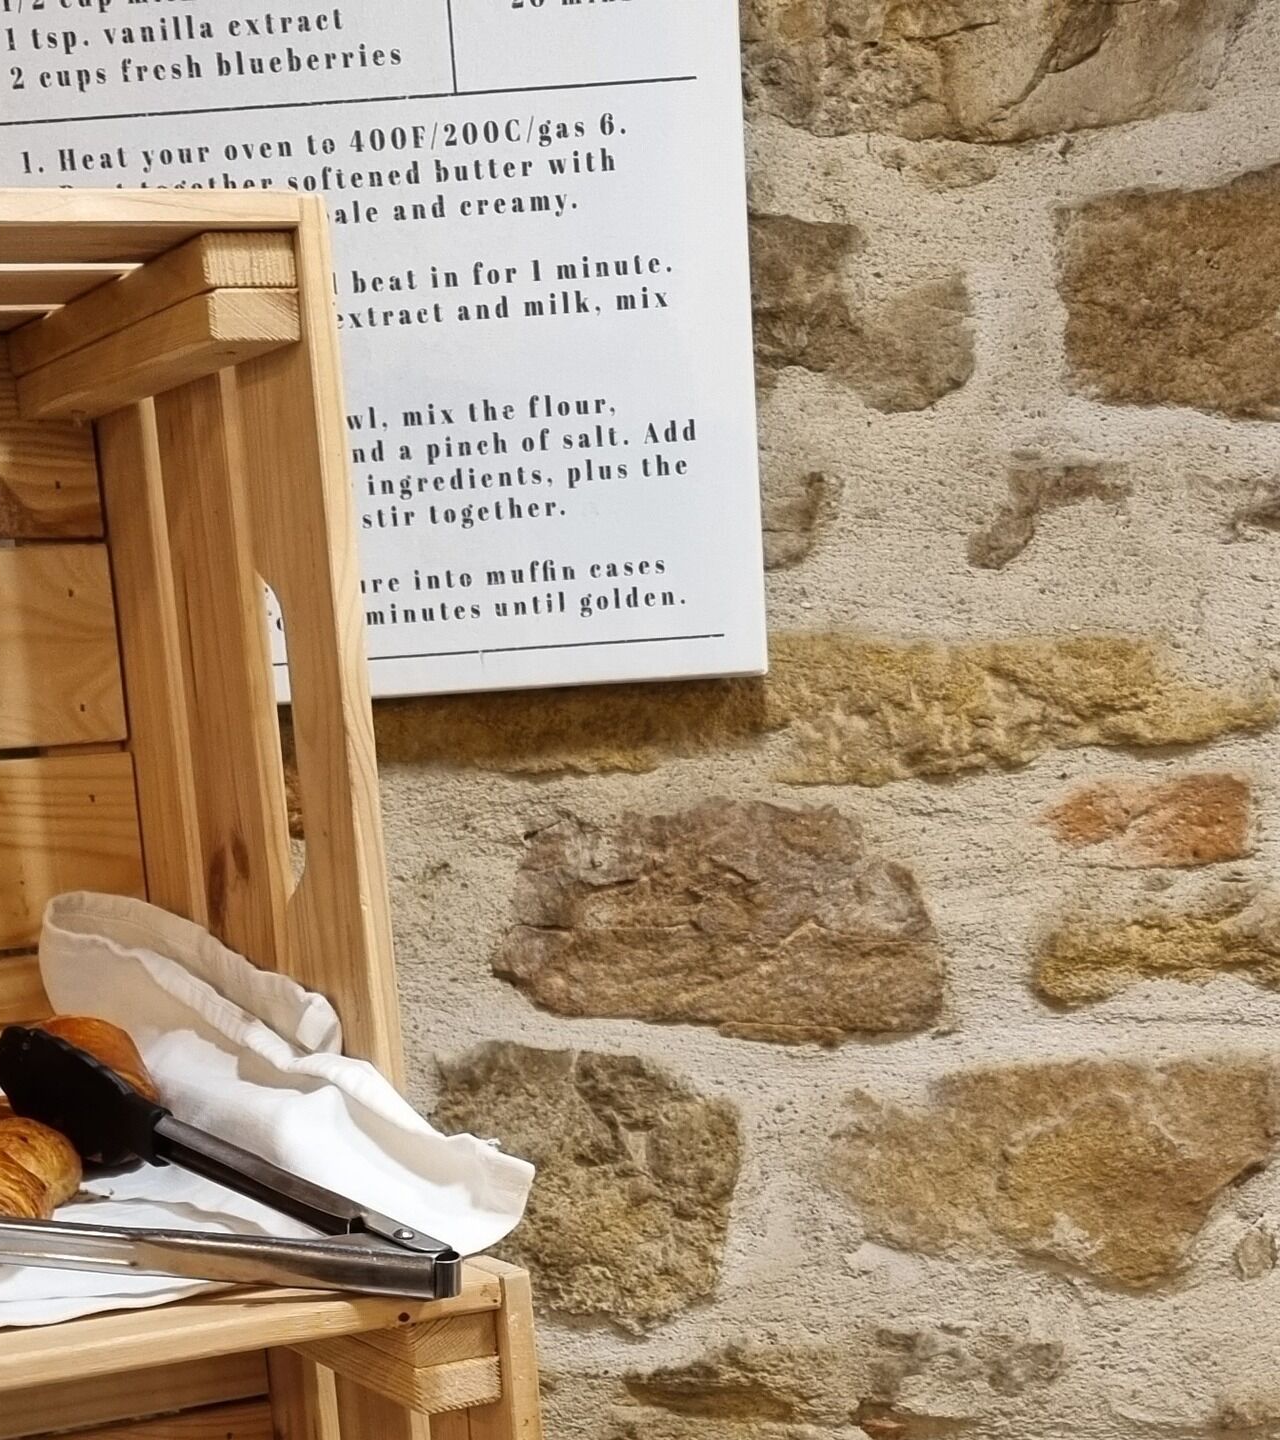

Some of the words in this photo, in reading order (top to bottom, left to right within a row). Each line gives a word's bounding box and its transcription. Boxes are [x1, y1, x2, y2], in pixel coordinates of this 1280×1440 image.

[5, 28, 17, 50] 1
[31, 28, 89, 54] tsp.
[103, 15, 214, 45] vanilla
[228, 8, 344, 37] extract
[10, 67, 25, 90] 2
[39, 66, 107, 92] cups
[121, 55, 202, 83] fresh
[216, 43, 402, 76] blueberries
[21, 151, 44, 174] 1.
[58, 147, 128, 172] Heat
[141, 146, 210, 173] your
[224, 139, 293, 161] oven
[307, 135, 336, 156] to
[349, 115, 585, 153] 400F/200C/gas
[599, 112, 627, 136] 6.
[287, 160, 420, 191] softened
[434, 158, 533, 183] butter
[548, 148, 616, 175] with
[328, 200, 379, 225] ale
[393, 194, 446, 221] and
[459, 193, 578, 217] creamy.
[351, 269, 418, 294] beat
[430, 266, 459, 289] in
[472, 261, 518, 286] for
[531, 259, 542, 282] 1
[556, 254, 673, 281] minute.
[457, 295, 510, 322] and
[523, 290, 602, 318] milk,
[616, 286, 669, 311] mix
[402, 403, 455, 427] mix
[469, 399, 516, 422] the
[529, 395, 616, 418] flour,
[399, 445, 412, 461] a
[426, 432, 508, 466] pinch
[521, 428, 550, 453] of
[563, 425, 630, 450] salt.
[644, 419, 697, 444] Add
[367, 466, 554, 501] ingredients,
[568, 459, 629, 489] plus
[642, 454, 688, 478] the
[362, 505, 416, 529] stir
[429, 498, 566, 529] together.
[413, 569, 473, 592] into
[486, 560, 576, 587] muffin
[589, 558, 667, 579] cases
[365, 603, 481, 626] minutes
[495, 592, 566, 618] until
[579, 586, 687, 618] golden.
